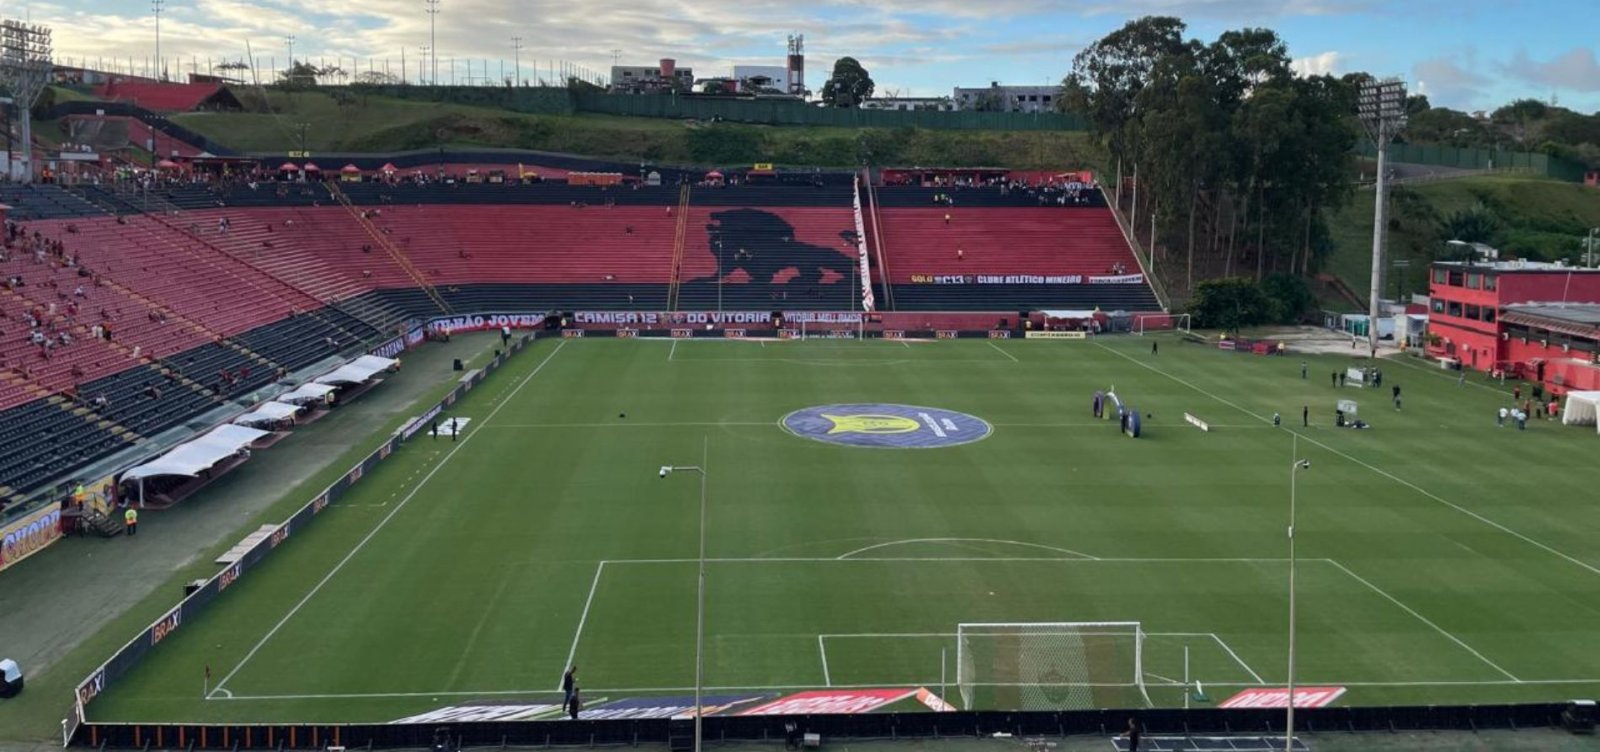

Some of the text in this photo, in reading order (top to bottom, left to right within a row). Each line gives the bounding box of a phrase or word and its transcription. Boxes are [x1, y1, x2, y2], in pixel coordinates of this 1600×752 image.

[977, 275, 1004, 284] CLUBE
[1046, 274, 1082, 284] MINEIRO
[488, 313, 546, 327] JOVEM
[574, 312, 771, 323] CAMISA 12 DO VITORIA
[220, 563, 240, 591] BRAX
[154, 610, 180, 643] BRAX
[79, 674, 102, 705] RAX
